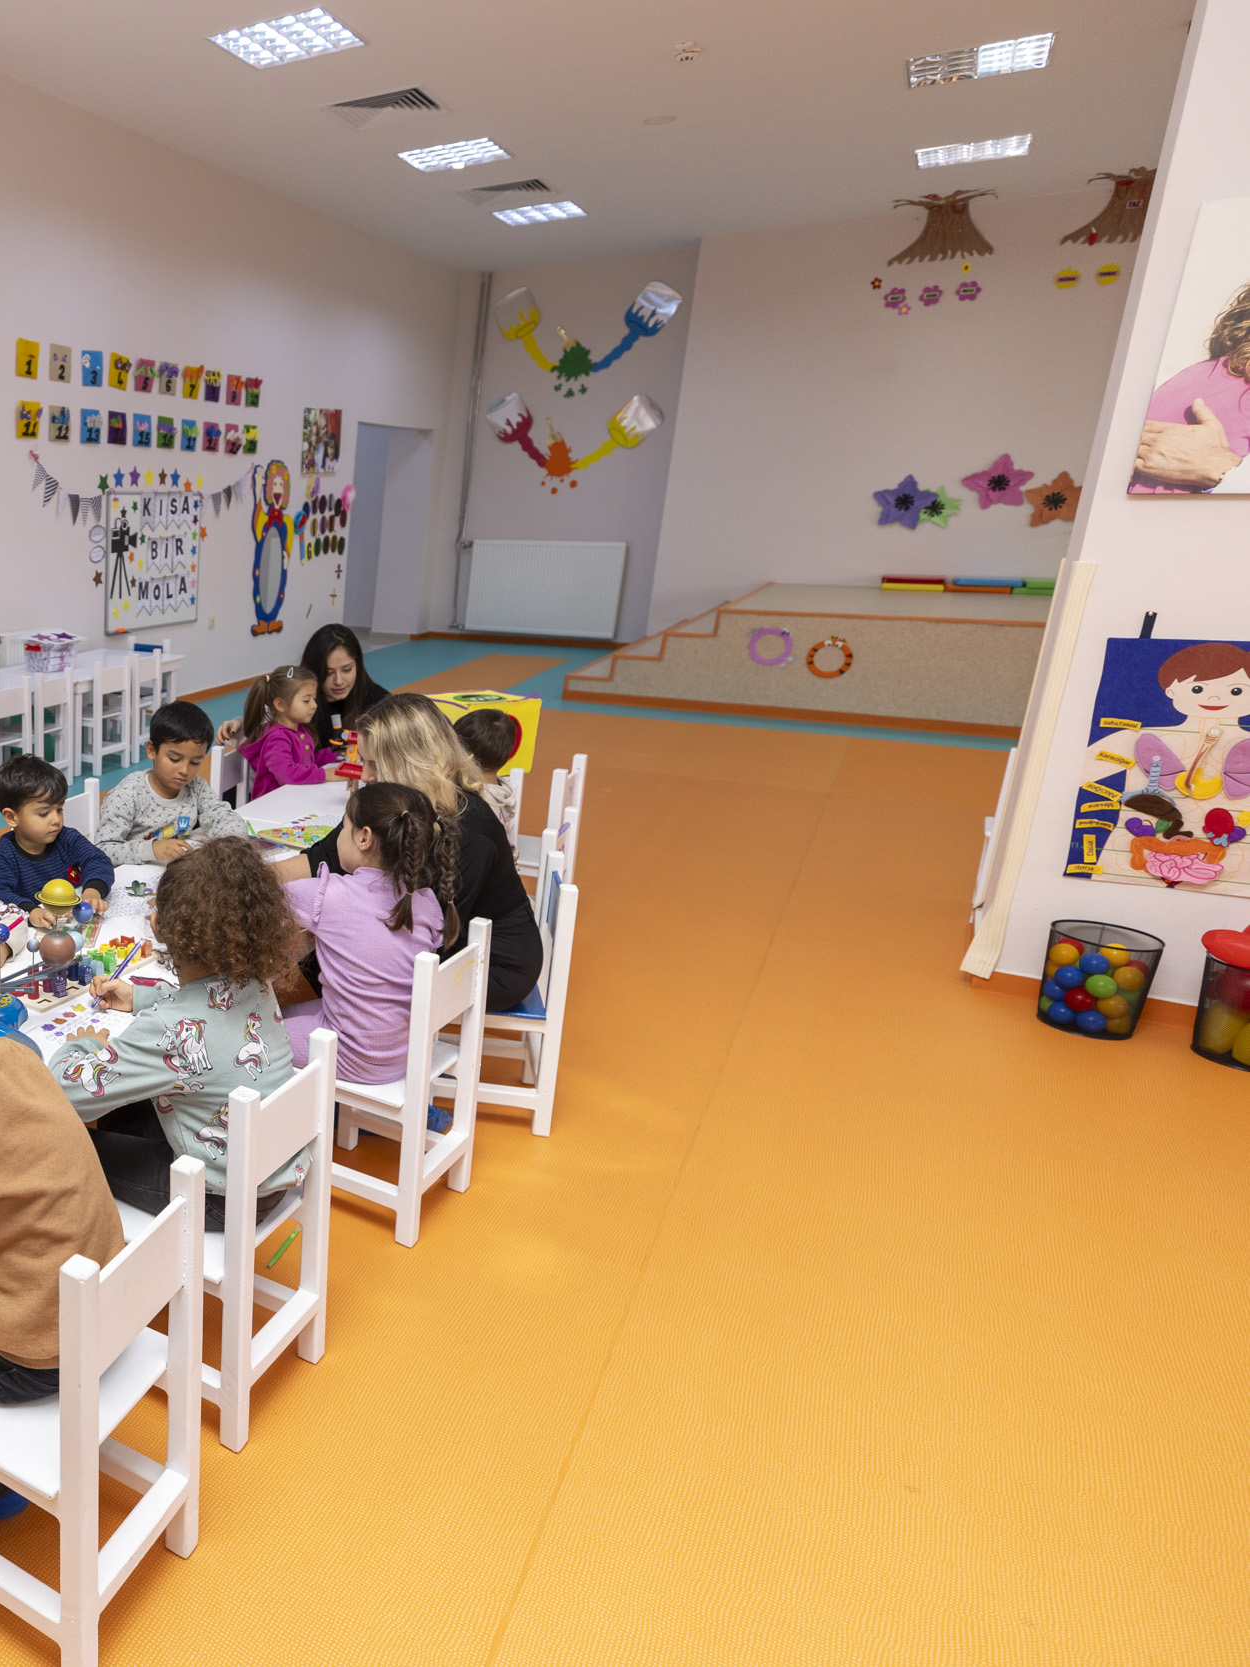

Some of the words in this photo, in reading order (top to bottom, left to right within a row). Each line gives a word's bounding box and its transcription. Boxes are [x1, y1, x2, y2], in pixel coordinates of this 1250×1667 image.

[25, 359, 33, 375] 1
[58, 364, 65, 380] 2
[90, 370, 98, 384] 3
[117, 371, 123, 386] 4
[141, 377, 150, 391] 5
[165, 380, 172, 392] 6
[189, 384, 196, 397] 7
[231, 391, 237, 402] 9
[22, 421, 38, 437] 11
[55, 425, 69, 440] 12
[86, 427, 100, 442] 13
[138, 431, 150, 445] 15
[161, 433, 173, 447] 16
[142, 495, 190, 517] KISA
[151, 537, 184, 560] BİR
[138, 576, 187, 601] MOLA
[1099, 752, 1132, 766] Karaciğer
[1086, 783, 1118, 799] Akciğer
